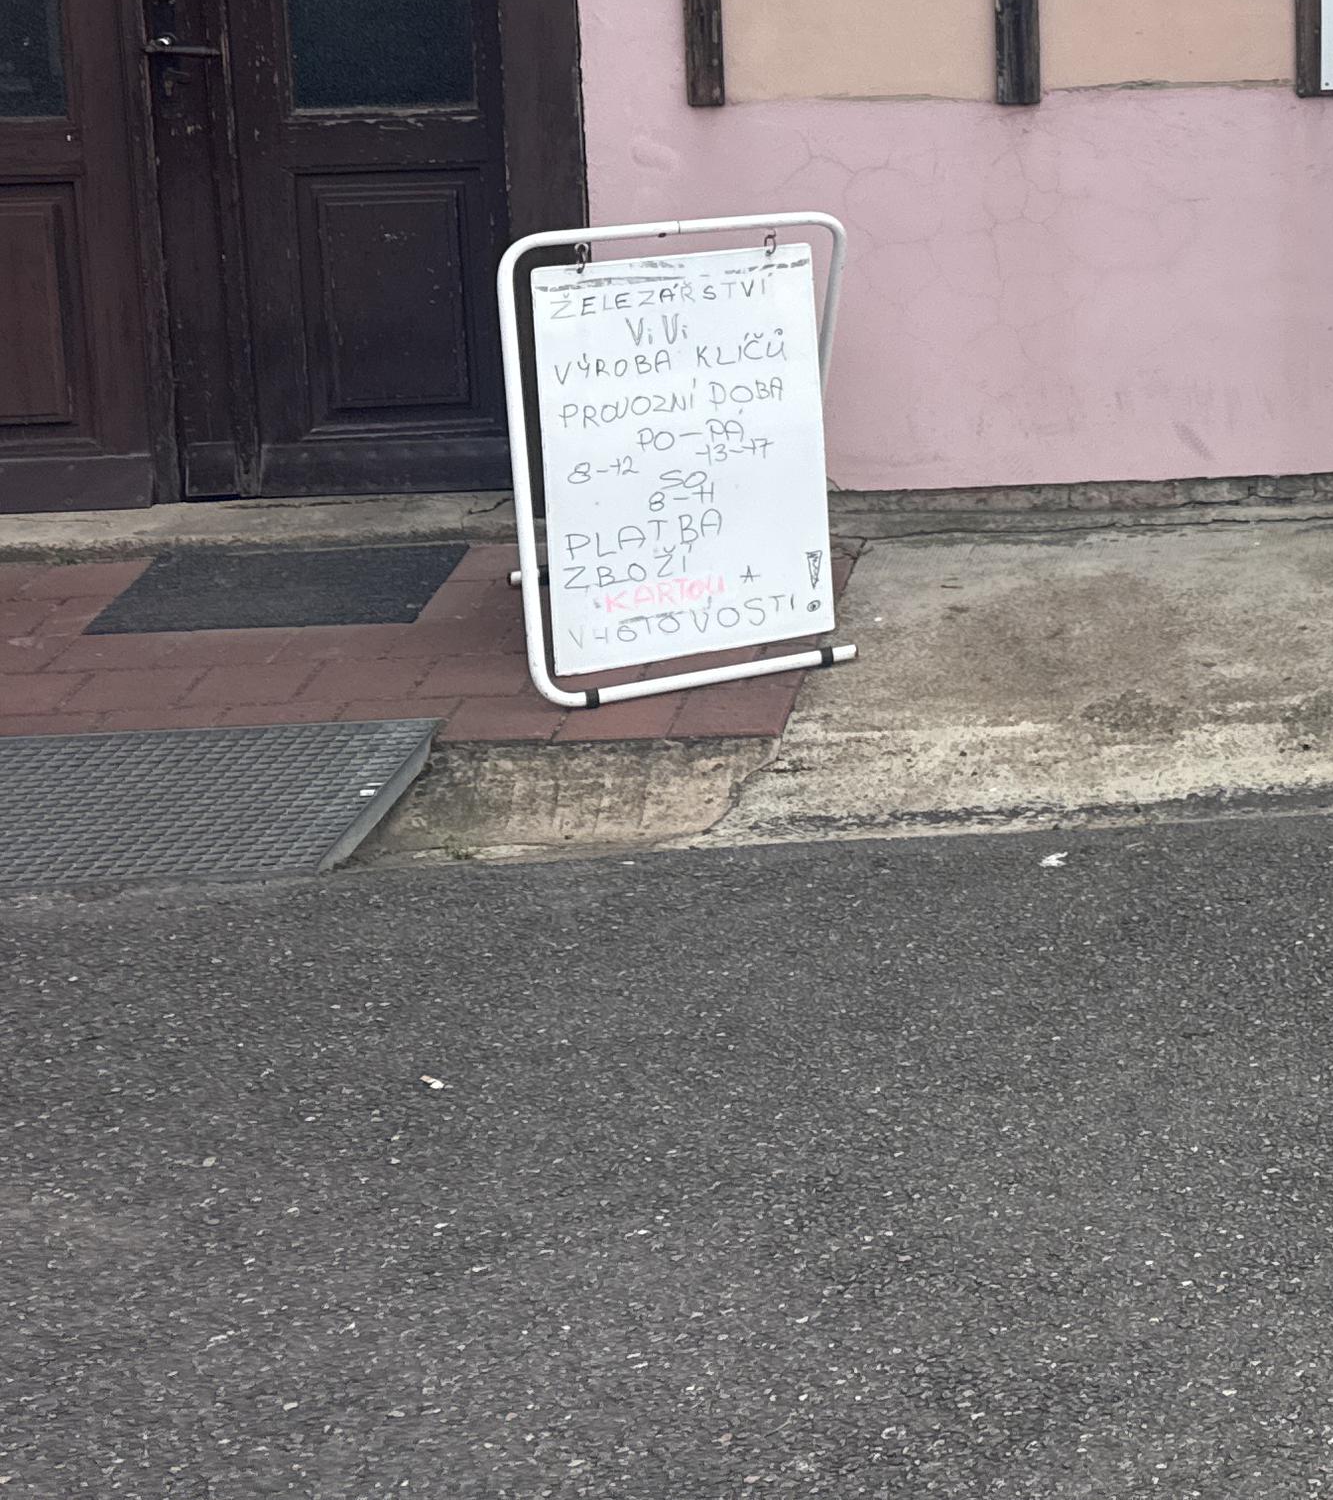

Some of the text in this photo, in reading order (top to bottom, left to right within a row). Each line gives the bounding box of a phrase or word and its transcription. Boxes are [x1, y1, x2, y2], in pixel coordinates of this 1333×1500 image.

[550, 272, 773, 320] ŽELEZÁŘSTVÍ
[554, 327, 788, 385] VÝROBA KLÍČŮ
[558, 376, 784, 429] PROVOZNÍ DOBA
[659, 469, 708, 490] SO
[564, 508, 723, 561] PLATBA
[562, 543, 693, 590] ZBOŽÍ
[739, 564, 761, 584] A
